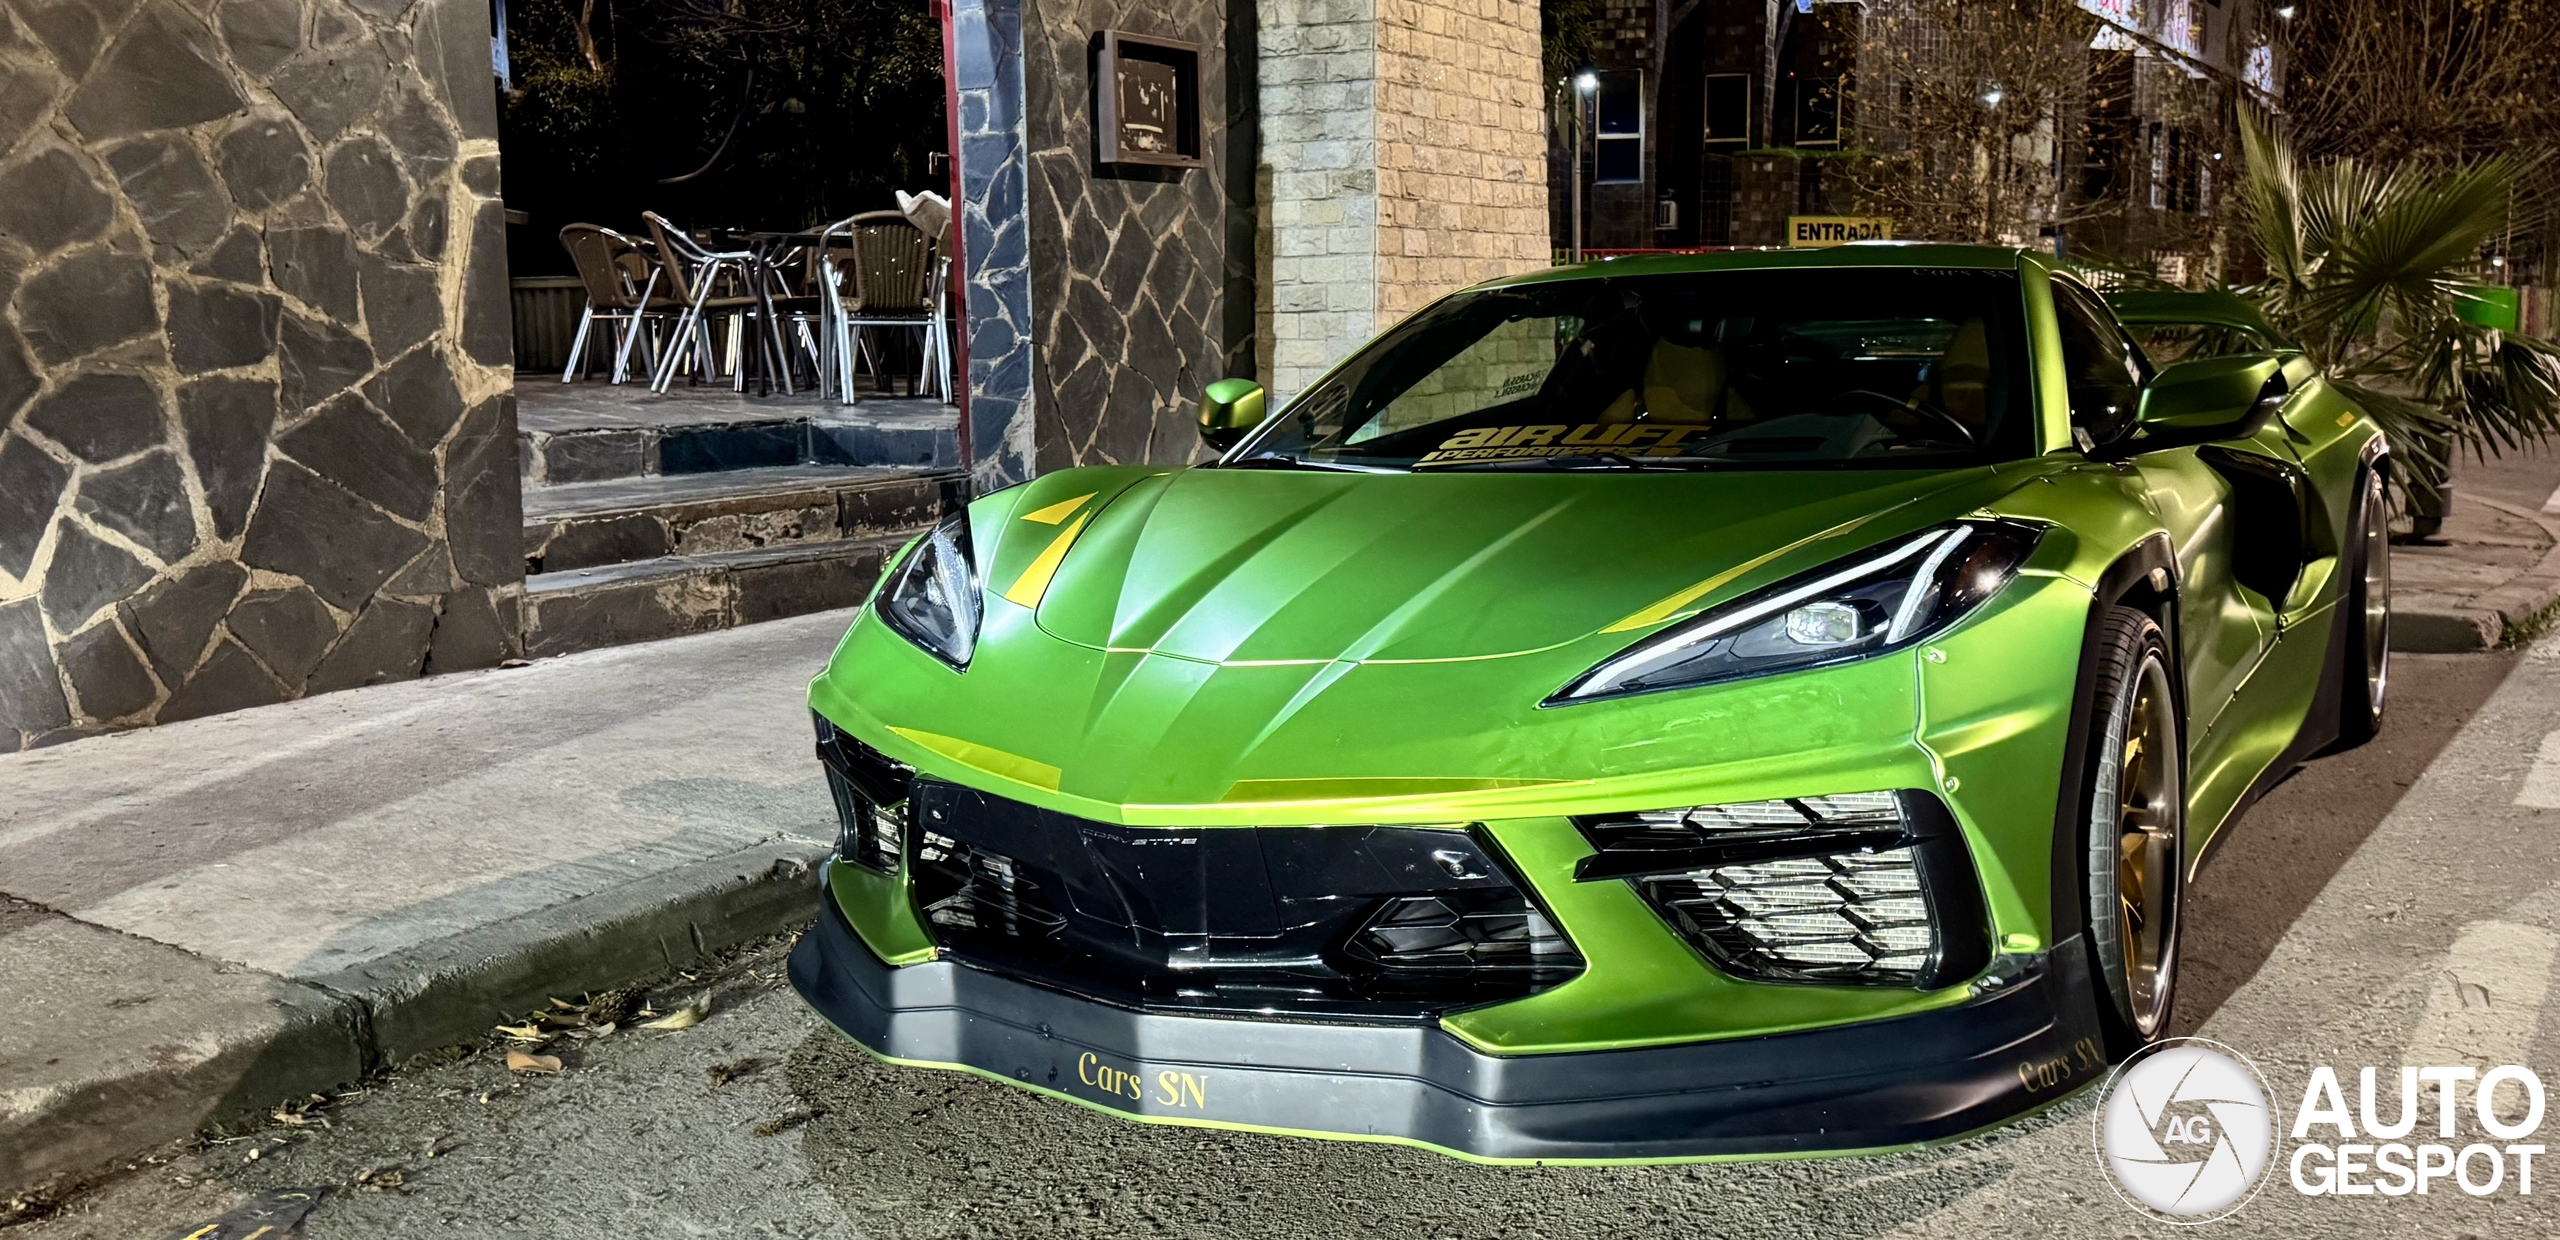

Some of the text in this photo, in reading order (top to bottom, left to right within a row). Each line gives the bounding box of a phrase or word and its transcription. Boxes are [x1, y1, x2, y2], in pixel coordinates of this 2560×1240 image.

[1796, 223, 1884, 241] ENTRADA
[1561, 424, 1711, 447] LIFT
[1083, 828, 1198, 846] CORVETTE
[1078, 1051, 1208, 1109] Cars SN
[2018, 1055, 2071, 1093] Cars
